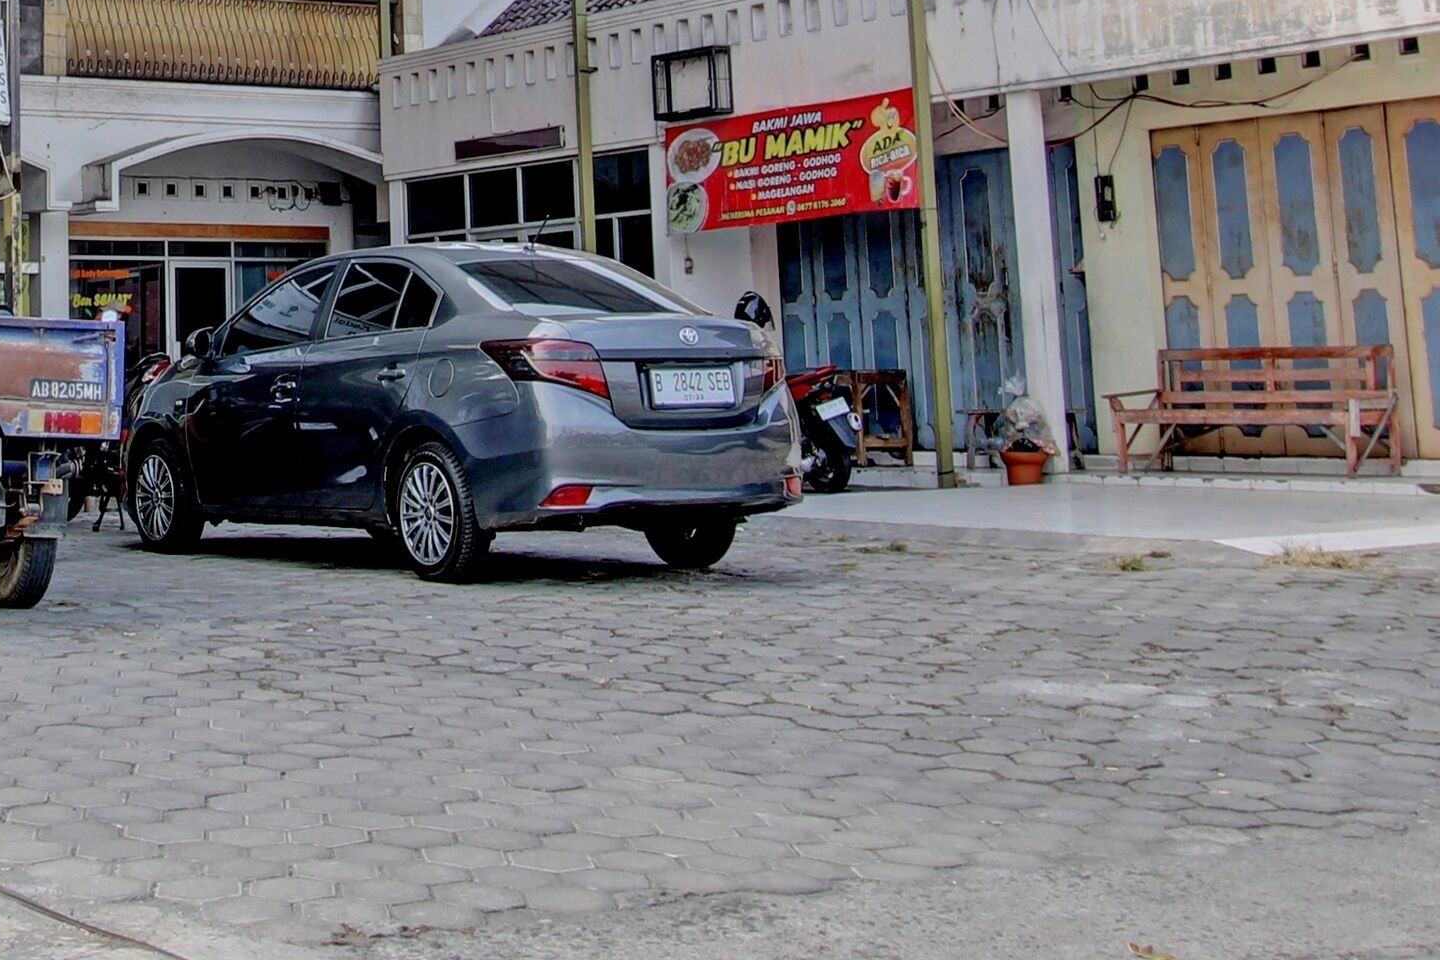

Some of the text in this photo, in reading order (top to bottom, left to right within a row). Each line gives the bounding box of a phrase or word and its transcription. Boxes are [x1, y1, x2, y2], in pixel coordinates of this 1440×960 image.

[752, 111, 823, 134] BAKMI JAWA
[872, 132, 902, 154] ADA
[760, 162, 796, 176] GORENG
[654, 371, 731, 392] B 2842 SEB
